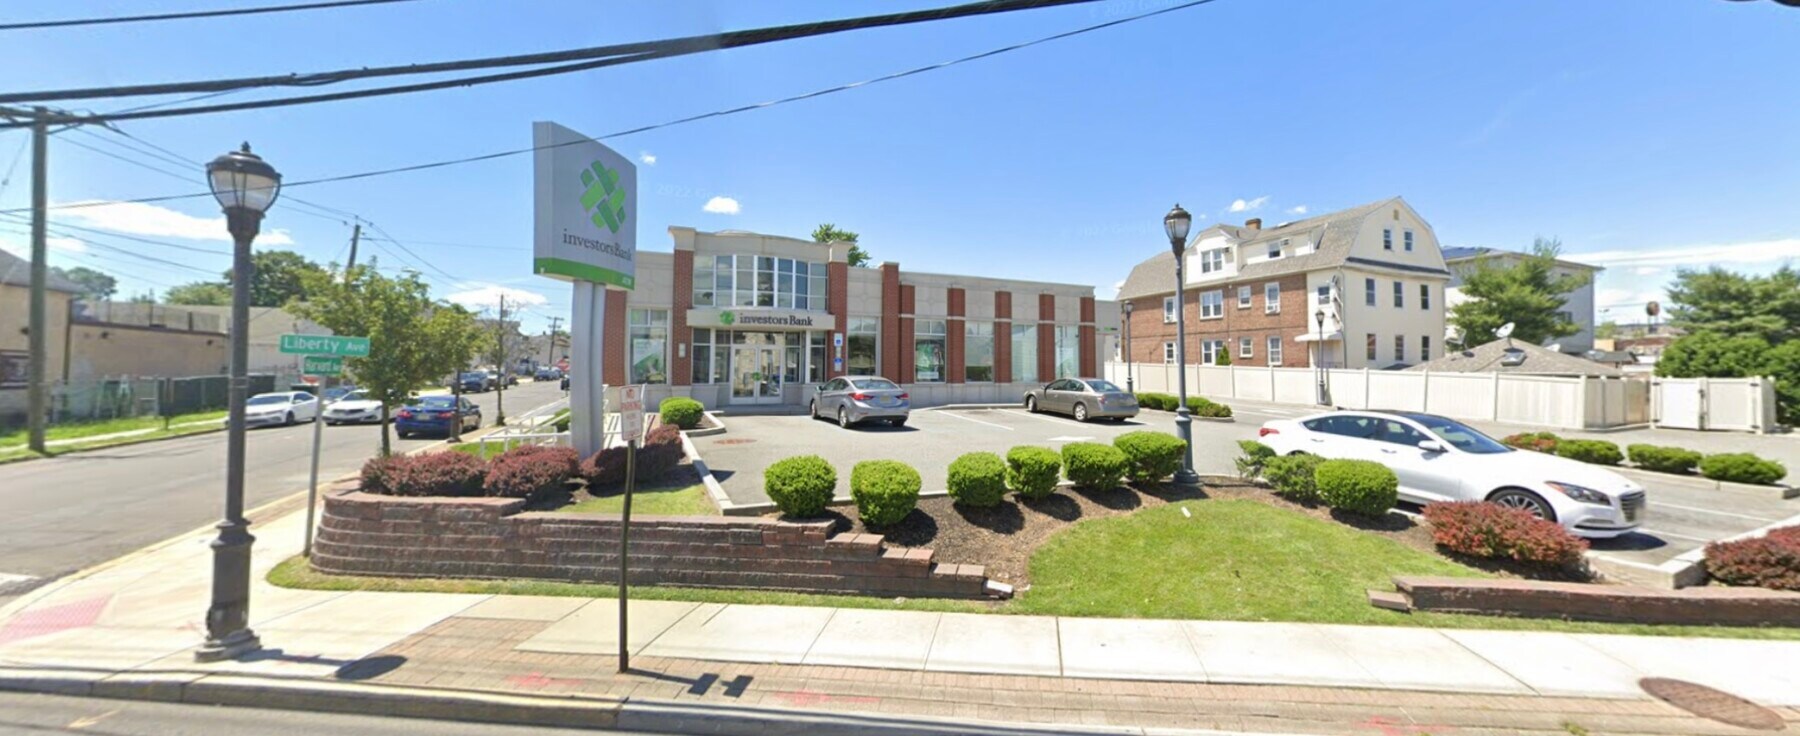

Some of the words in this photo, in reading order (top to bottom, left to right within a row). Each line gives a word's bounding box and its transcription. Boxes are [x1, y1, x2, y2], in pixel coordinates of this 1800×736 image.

[562, 228, 632, 261] investorsBank
[284, 336, 339, 353] Liberty
[345, 342, 366, 352] Ave
